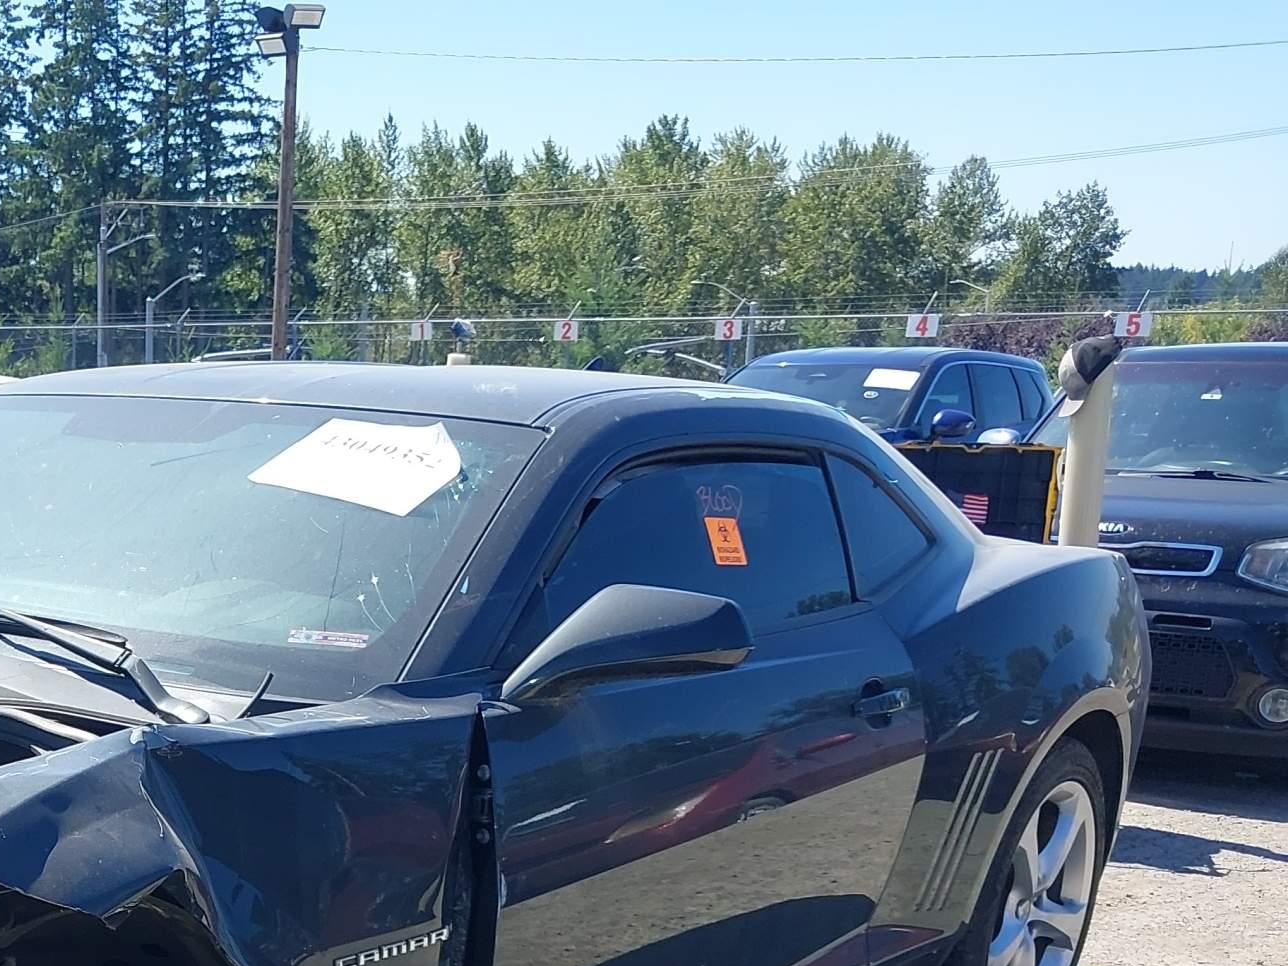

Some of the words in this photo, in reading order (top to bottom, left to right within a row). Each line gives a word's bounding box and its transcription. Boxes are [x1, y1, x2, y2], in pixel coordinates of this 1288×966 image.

[561, 322, 572, 339] 2
[723, 321, 735, 339] 3
[915, 316, 929, 336] 4
[1126, 314, 1142, 336] 5
[1098, 522, 1124, 532] KIA
